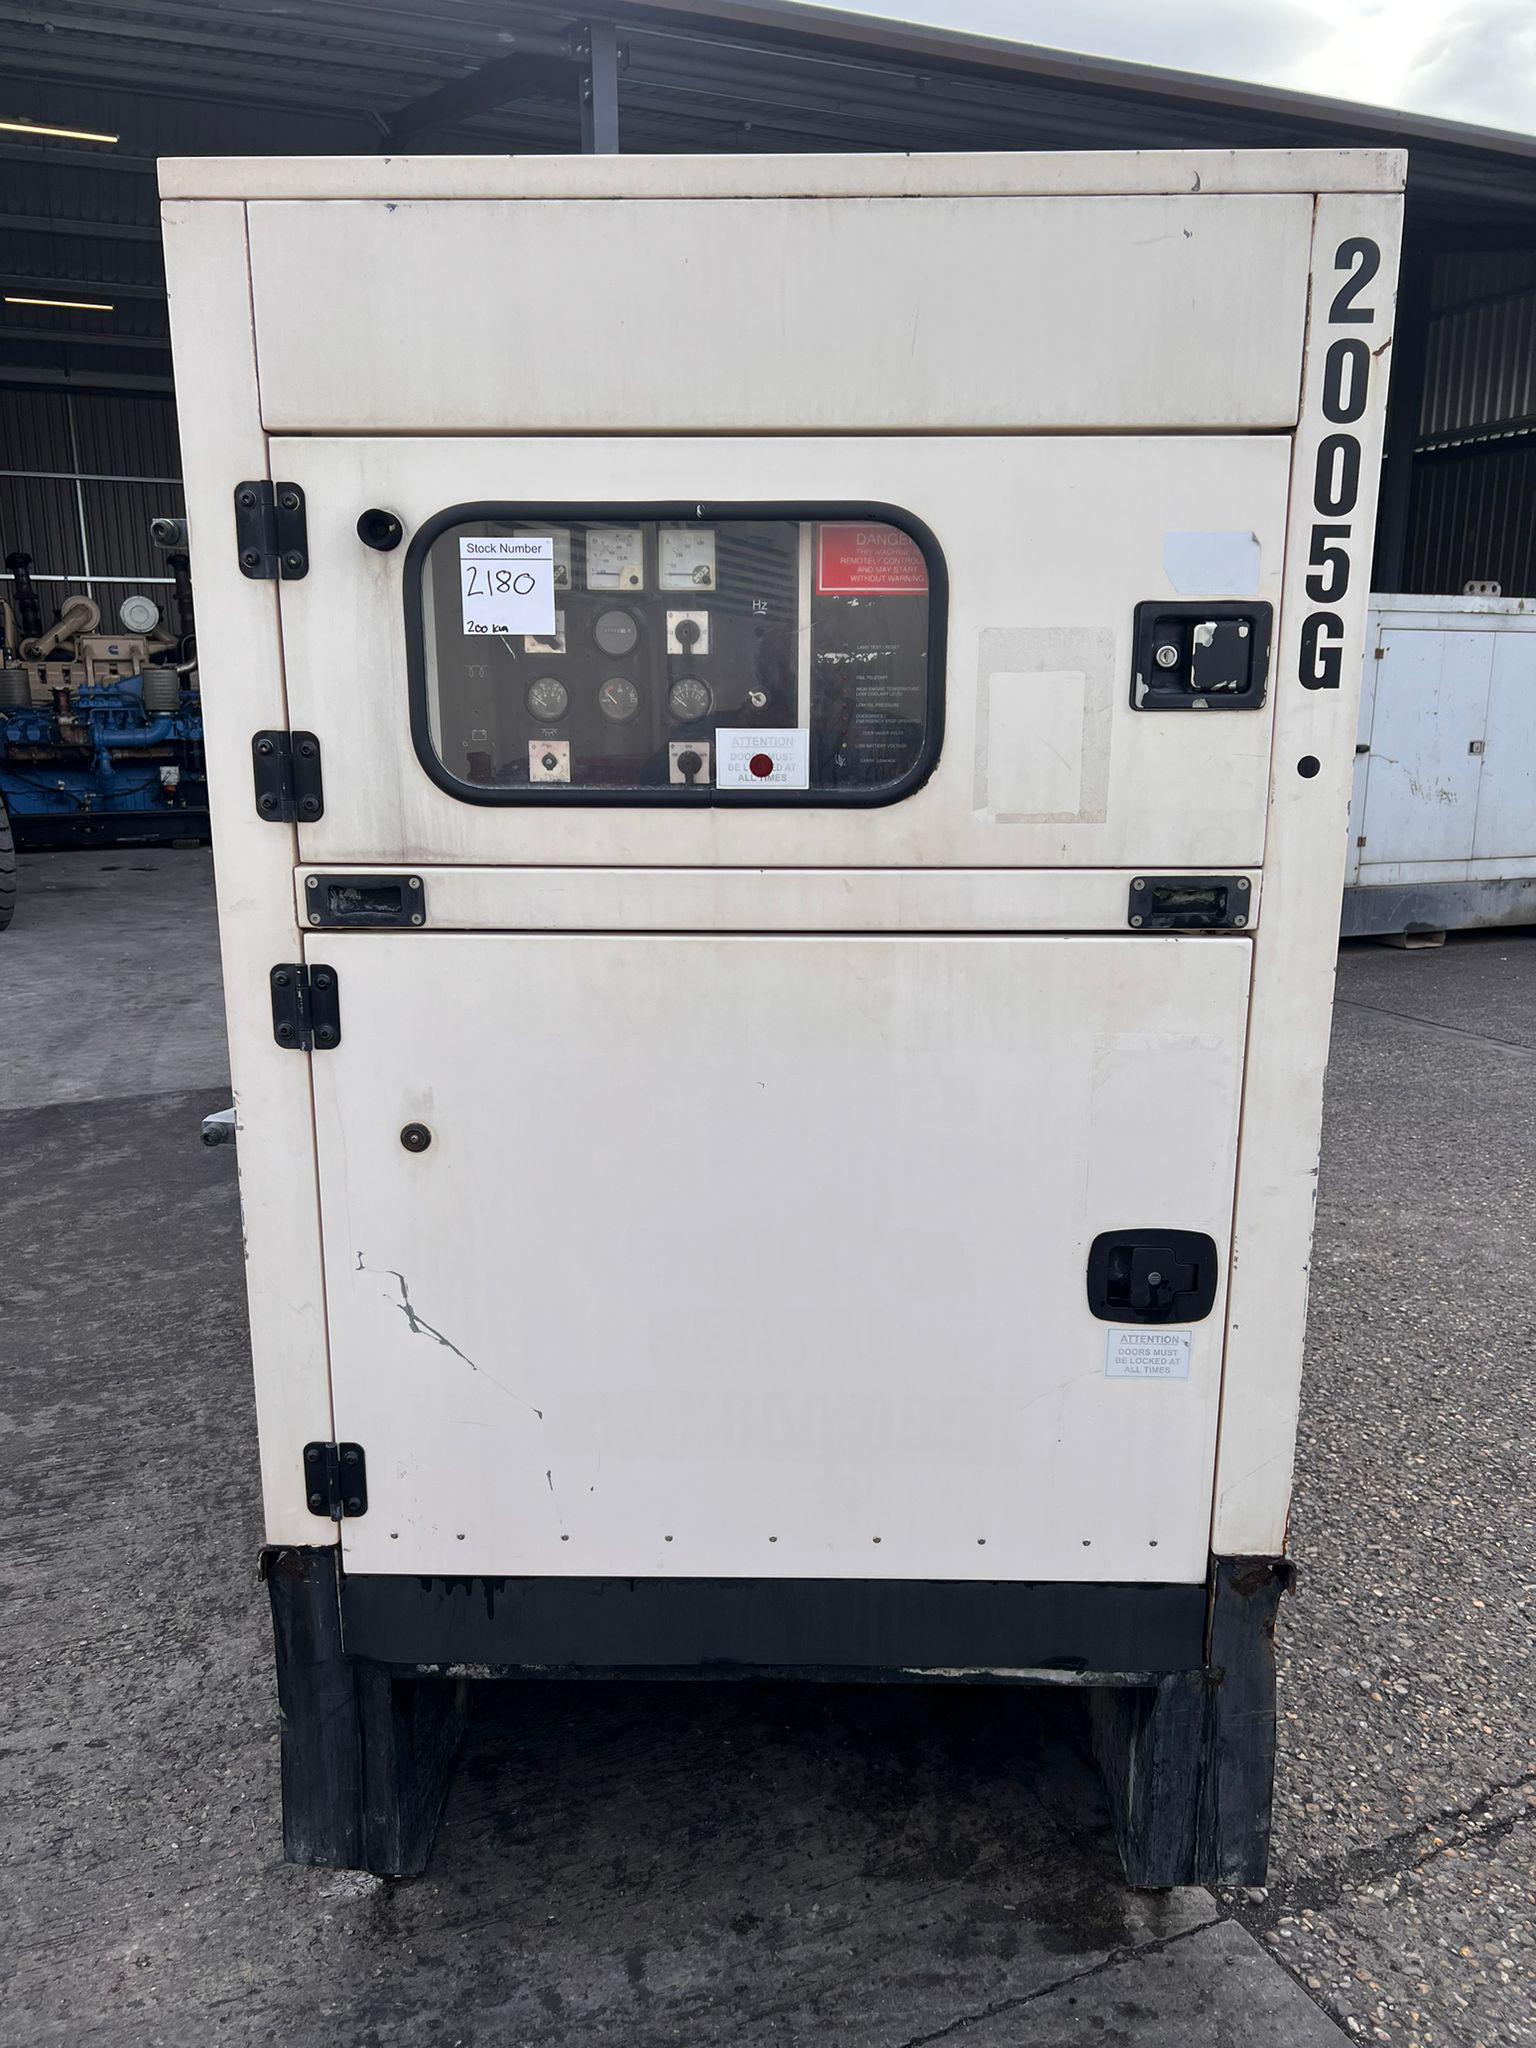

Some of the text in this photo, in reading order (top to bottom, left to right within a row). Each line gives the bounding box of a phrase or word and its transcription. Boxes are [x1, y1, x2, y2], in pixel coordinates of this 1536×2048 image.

[1298, 236, 1381, 691] 2005G
[466, 543, 542, 554] Stock Number
[840, 557, 881, 565] REMOTELY
[857, 566, 918, 574] AND MAY START
[466, 566, 536, 596] 2180
[850, 575, 924, 583] WITHOUT WARNING
[752, 599, 768, 610] Hz
[466, 620, 489, 634] 200
[732, 736, 794, 747] ATTENTION
[728, 763, 741, 772] BE
[785, 763, 796, 772] AT
[1120, 1334, 1180, 1344] ATTENTION
[1118, 1348, 1179, 1357] DOORS MUST
[1129, 1357, 1167, 1365] LOCKED
[1168, 1358, 1181, 1366] AT
[1124, 1366, 1171, 1374] ALL TIMES
